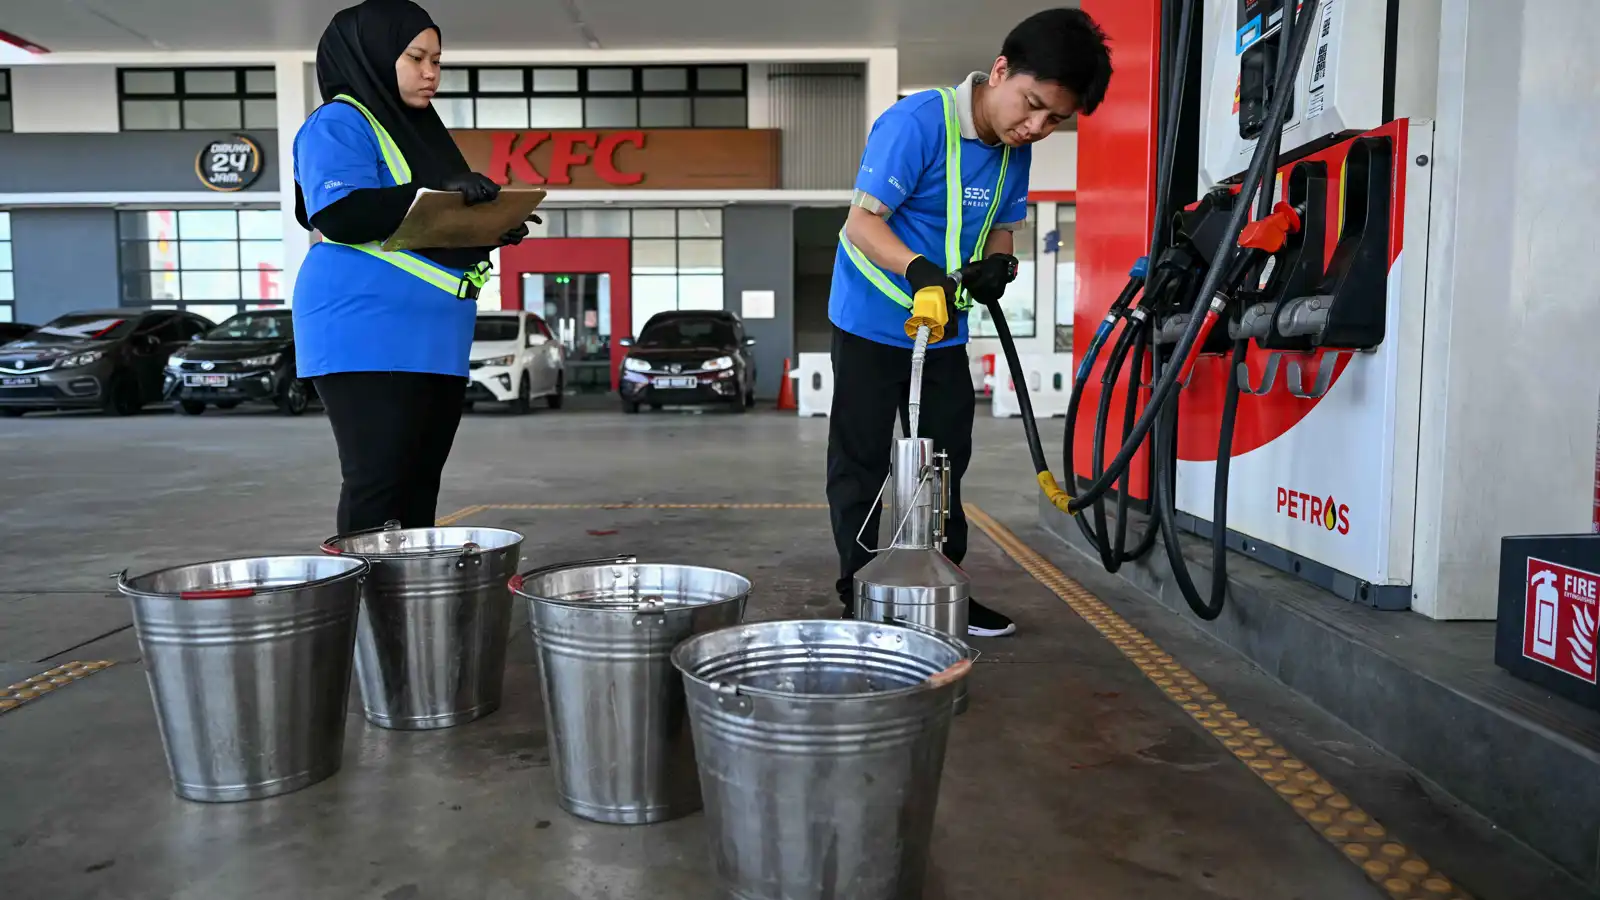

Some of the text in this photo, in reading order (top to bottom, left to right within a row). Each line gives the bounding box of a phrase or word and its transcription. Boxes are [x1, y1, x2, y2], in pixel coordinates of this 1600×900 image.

[210, 143, 251, 153] DIBUKA
[211, 153, 247, 172] 24
[487, 131, 645, 185] KFC
[962, 200, 989, 208] ENERGY
[1277, 486, 1350, 536] PETROS
[1564, 574, 1597, 599] FIRE
[1563, 591, 1596, 606] EXTINGUISHER
